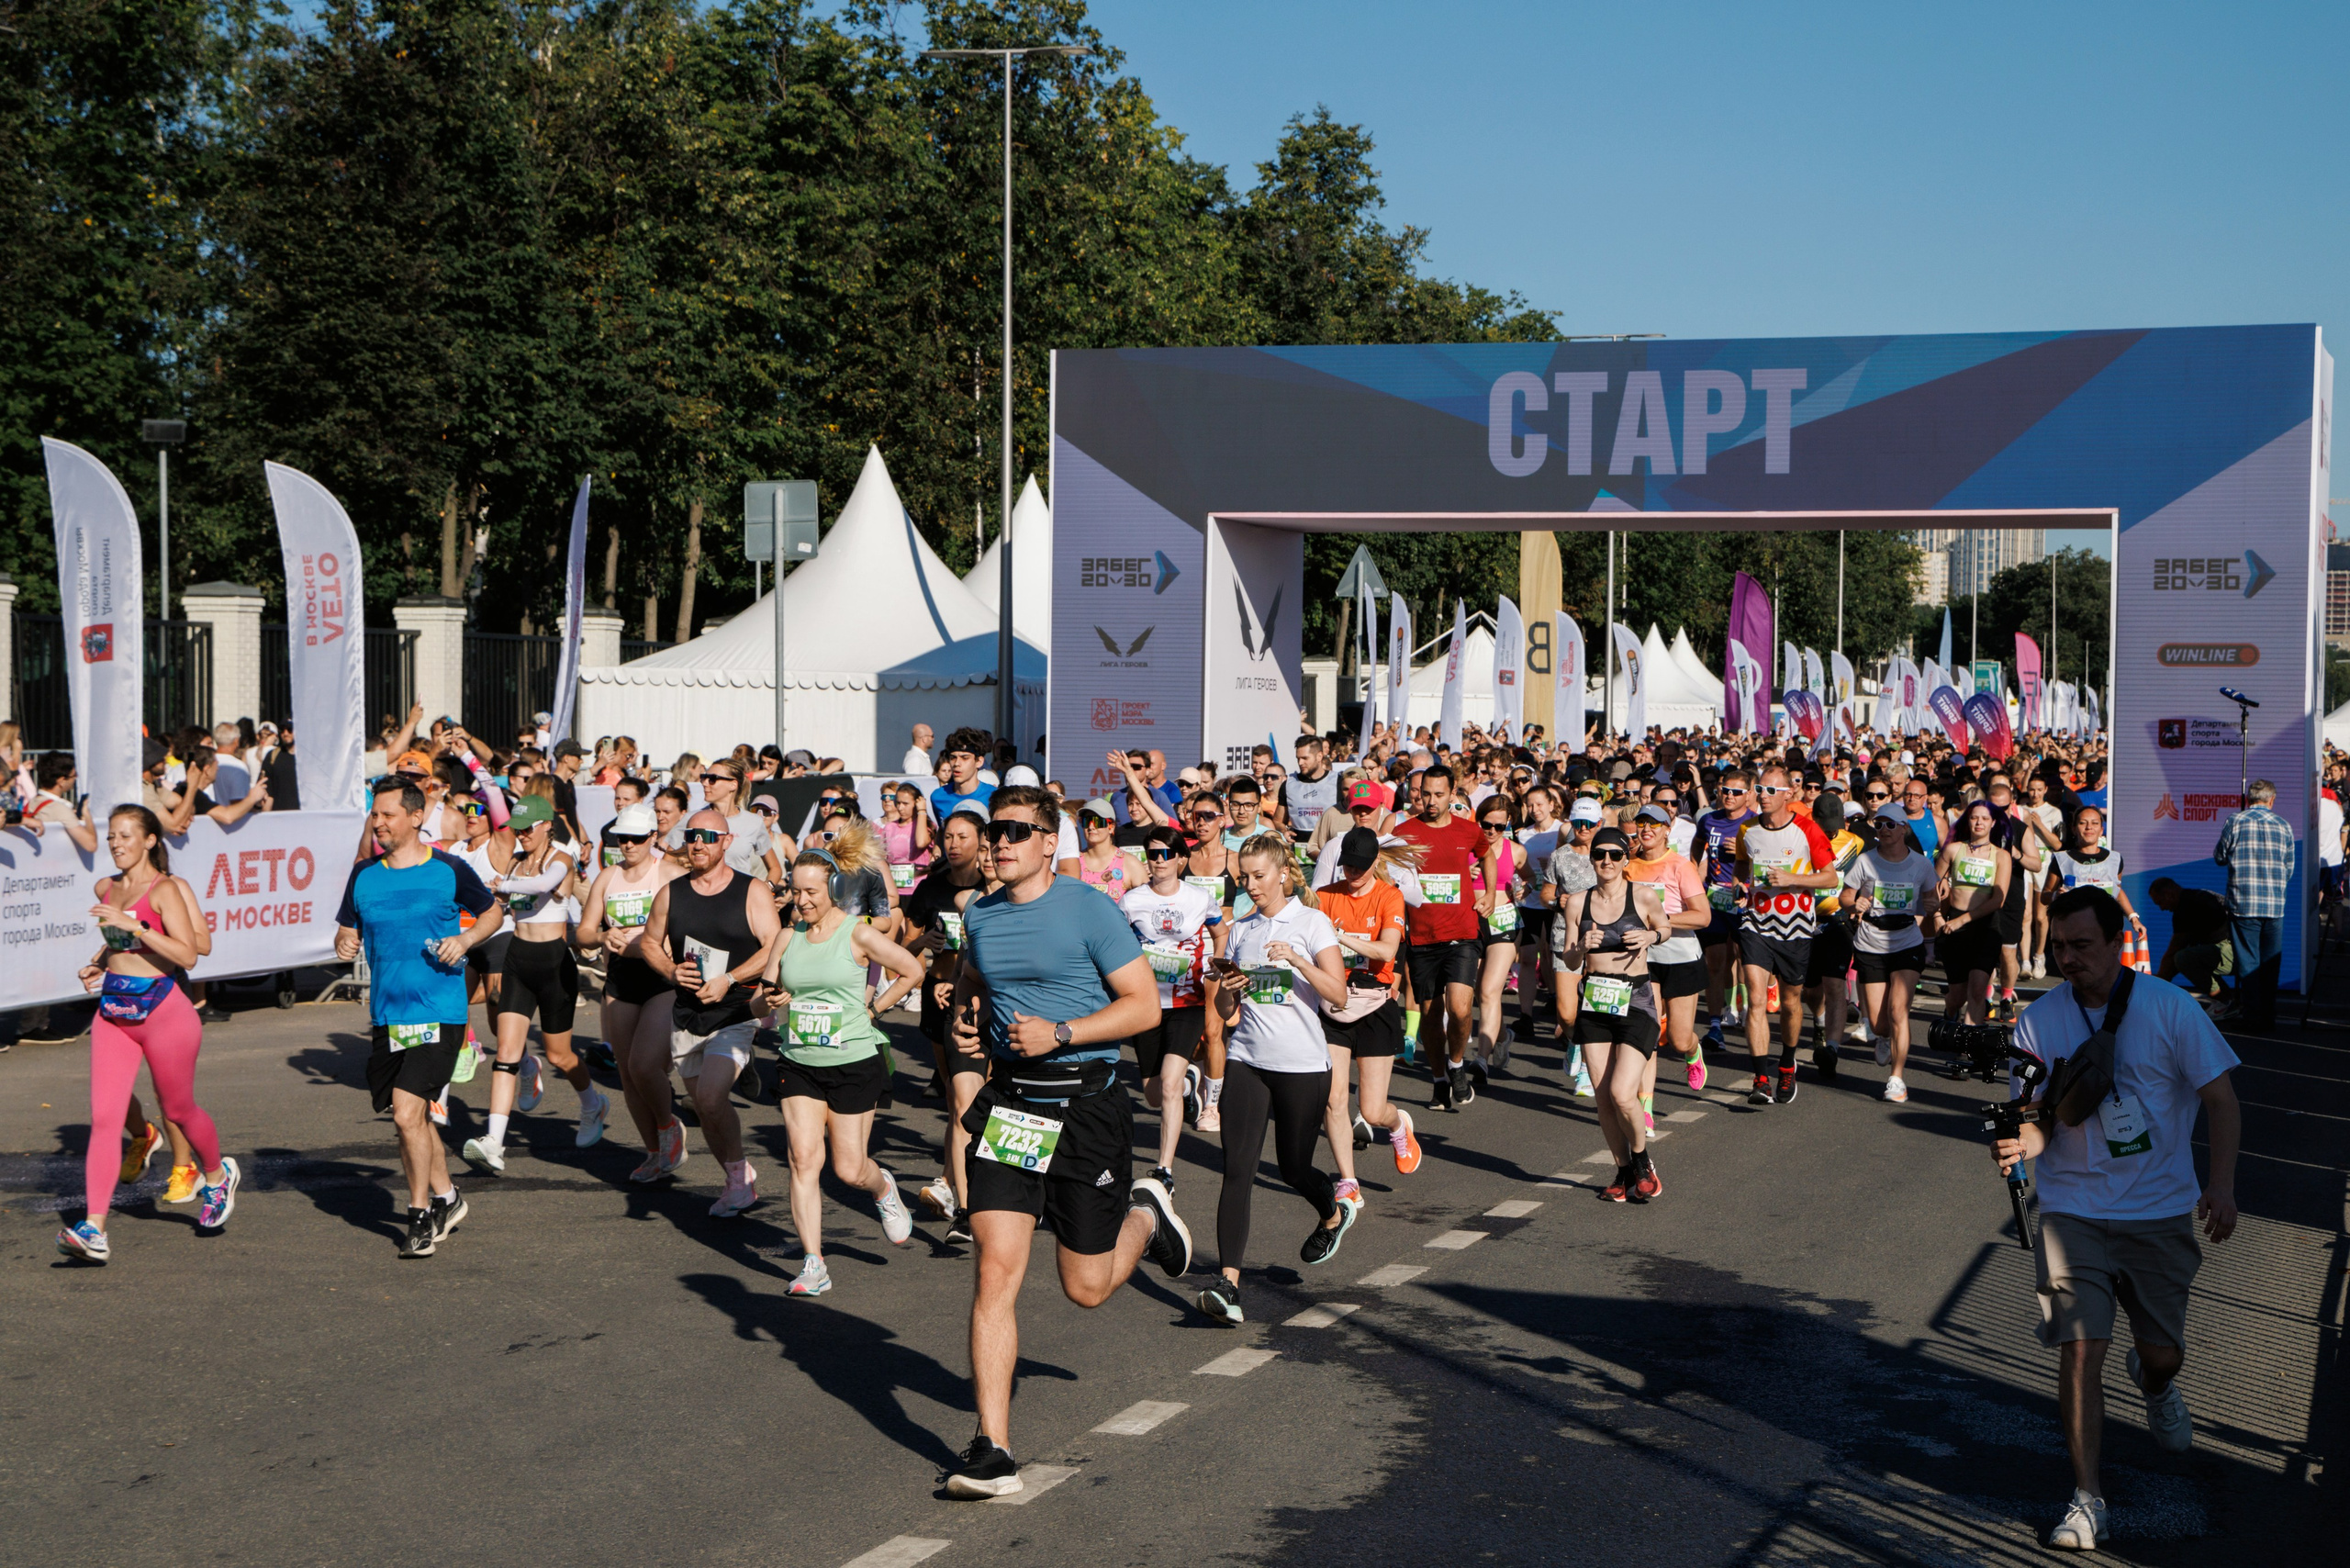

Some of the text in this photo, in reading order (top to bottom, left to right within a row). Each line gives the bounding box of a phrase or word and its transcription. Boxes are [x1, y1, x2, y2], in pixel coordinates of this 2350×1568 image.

[1488, 367, 1807, 477] СТАРТ
[1081, 557, 1151, 573] ЗАБЕГ
[2154, 557, 2241, 574] ЗАБЕГ
[2165, 648, 2237, 663] WINLINE
[1235, 677, 1277, 691] ЛИГА ГЕРОЕВ
[2191, 730, 2221, 738] спорта
[2191, 739, 2221, 747] города
[1226, 745, 1256, 770] ЗАБ
[2183, 793, 2248, 808] МОСКОВСК
[2183, 808, 2219, 822] СПОРТ
[206, 846, 315, 899] ЛЕТО
[3, 874, 75, 896] Департамент
[1446, 895, 1454, 903] D
[1882, 889, 1907, 902] 7283
[3, 902, 41, 921] спорта
[615, 900, 643, 917] 5169
[225, 901, 313, 932] МОСКВЕ
[637, 915, 646, 924] D
[3, 927, 41, 947] города
[45, 921, 87, 939] Москвы
[1148, 955, 1181, 974] 6868
[1168, 974, 1178, 984] D
[1273, 993, 1284, 1003] D
[1592, 986, 1620, 1004] 5251
[1610, 1005, 1619, 1014] D
[797, 1014, 832, 1034] 5670
[423, 1031, 433, 1041] D
[820, 1035, 830, 1046] D
[996, 1124, 1044, 1156] 7232
[2120, 1142, 2143, 1154] ПРЕССА
[1024, 1155, 1037, 1169] D
[1095, 1176, 1115, 1187] adidas
